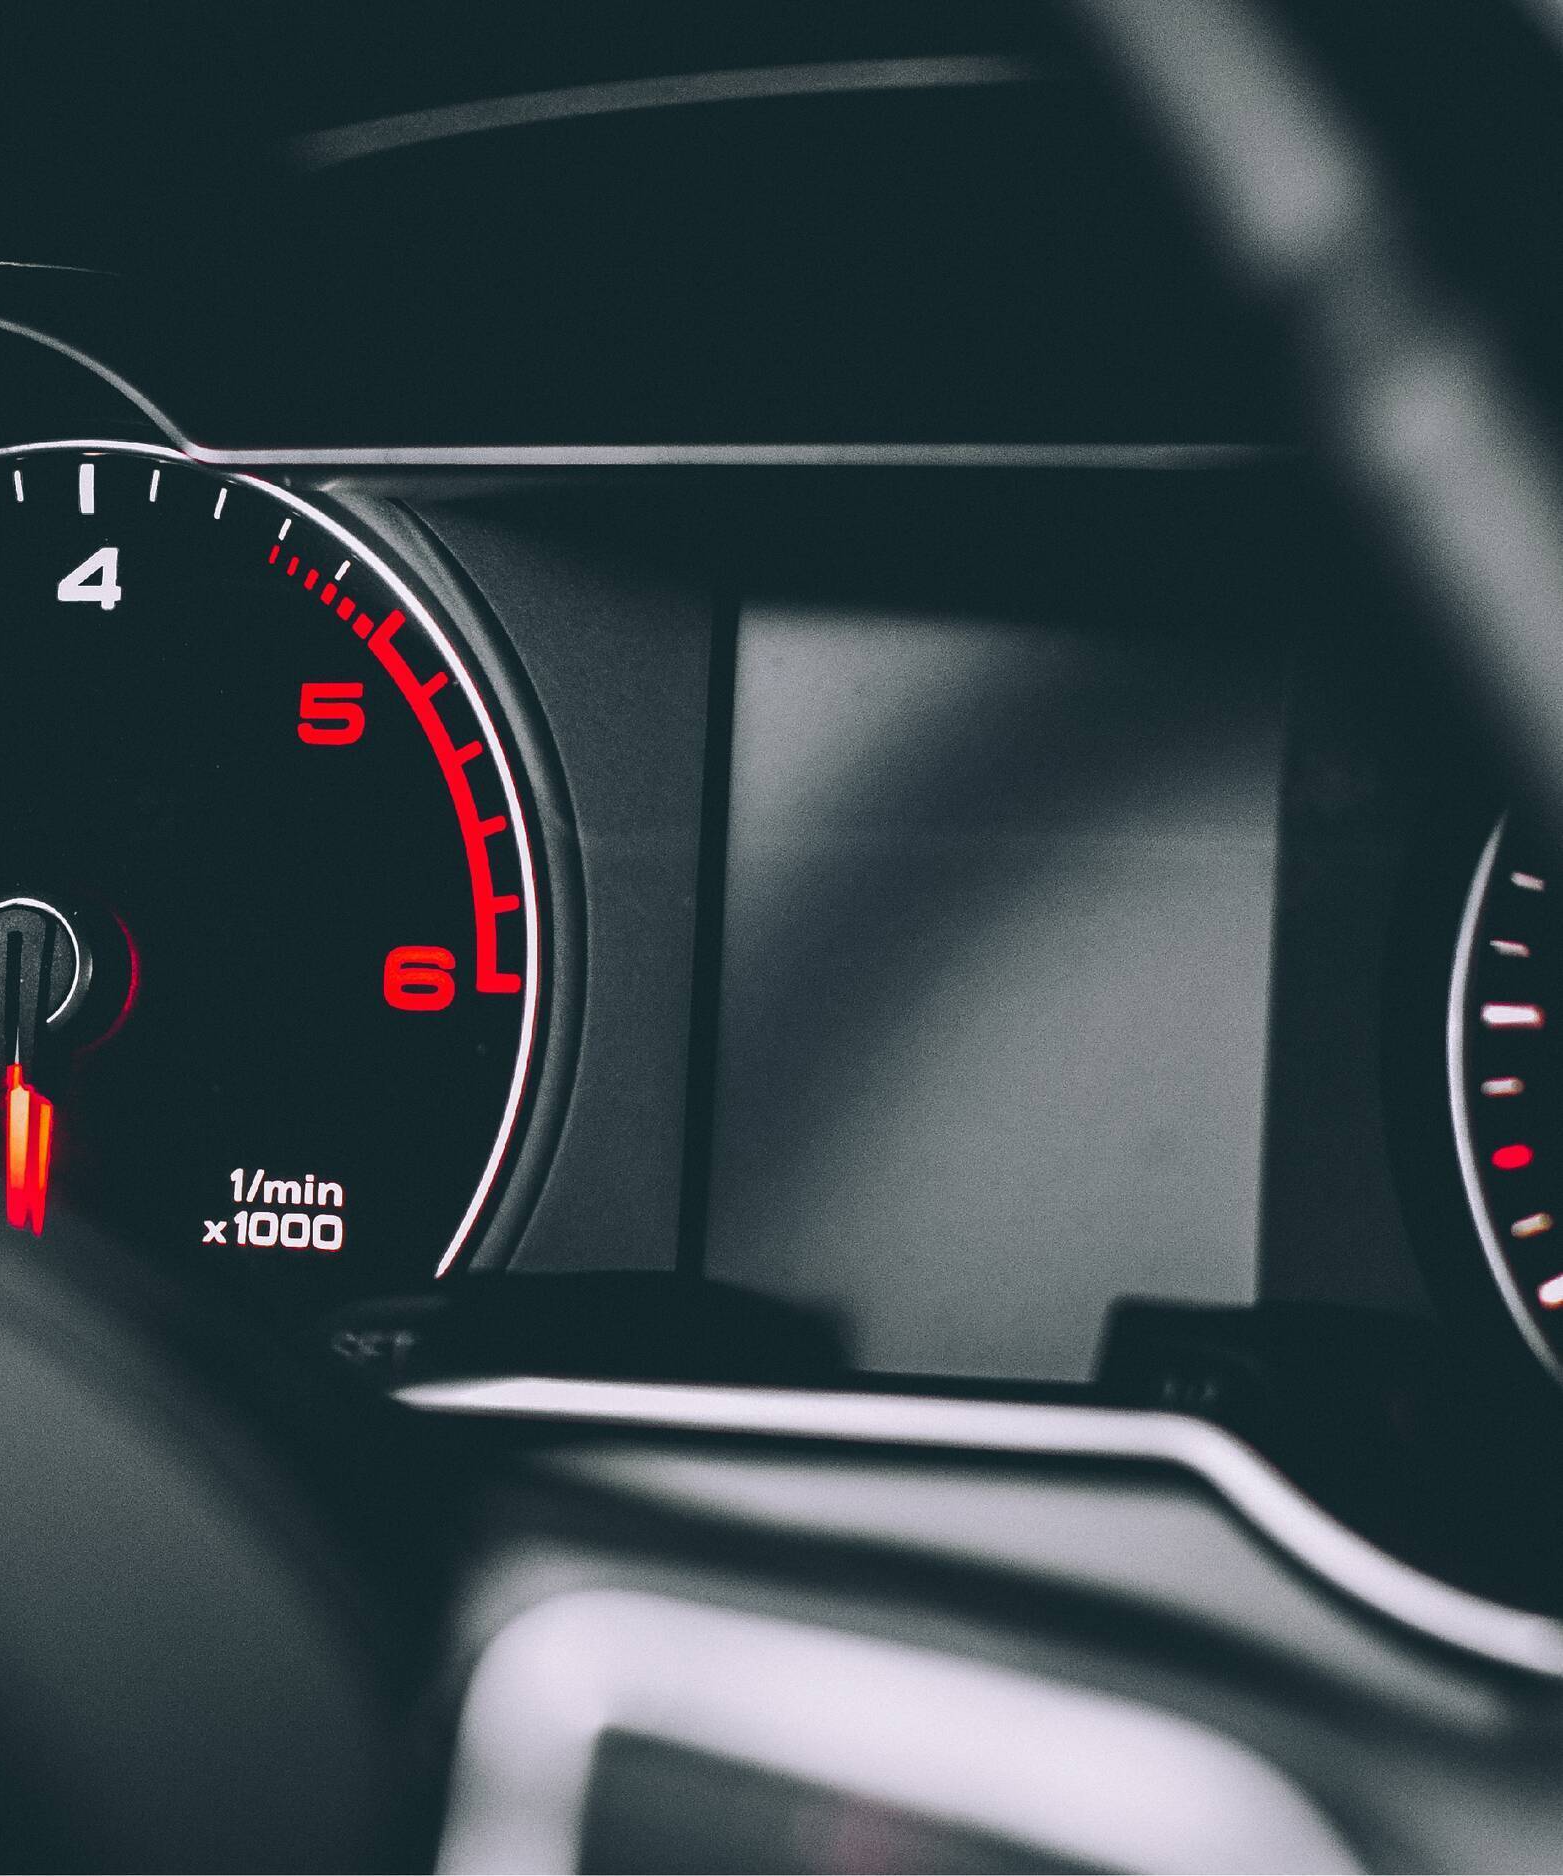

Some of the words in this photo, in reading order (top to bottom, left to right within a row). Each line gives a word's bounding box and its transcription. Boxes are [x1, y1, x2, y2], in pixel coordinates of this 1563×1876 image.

[57, 546, 122, 611] 4
[297, 682, 366, 745] 5
[383, 946, 457, 1011] 6
[230, 1168, 343, 1207] 1/min
